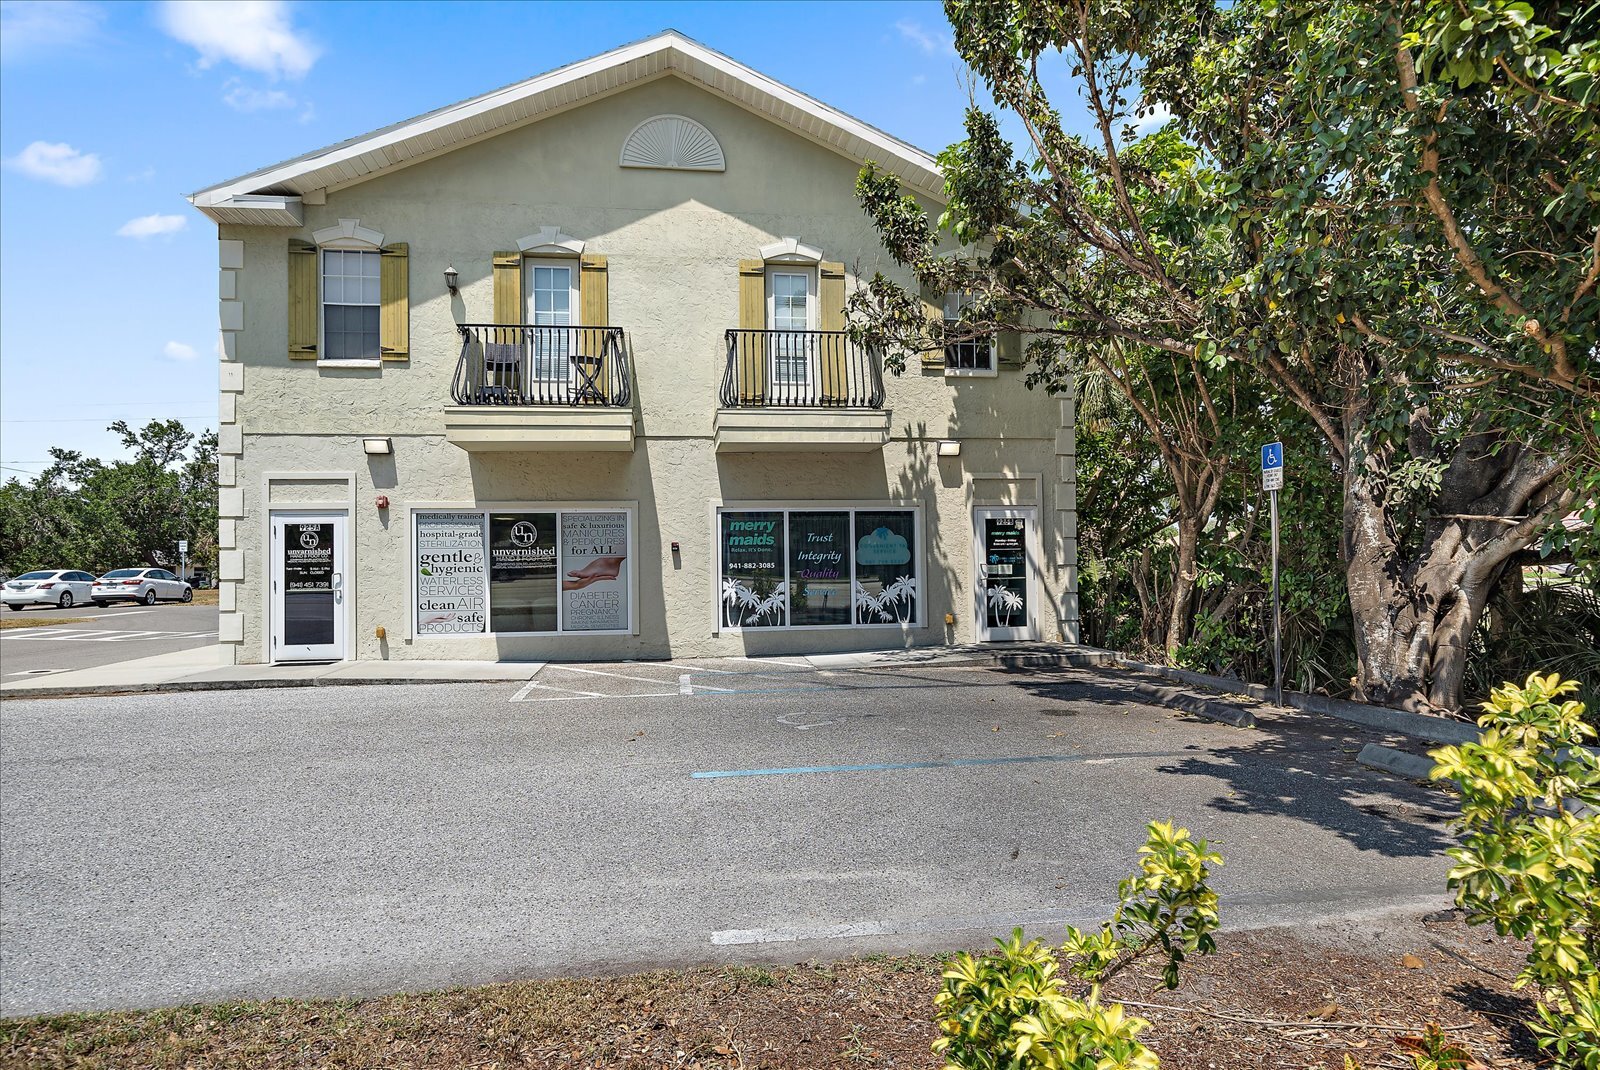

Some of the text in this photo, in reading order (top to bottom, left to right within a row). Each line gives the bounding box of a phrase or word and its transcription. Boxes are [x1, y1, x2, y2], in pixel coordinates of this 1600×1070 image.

[420, 513, 455, 521] medically
[730, 521, 775, 532] merry
[420, 530, 483, 540] hospital-grade
[563, 529, 624, 537] MANICURES
[808, 533, 833, 542] Trust
[730, 534, 774, 545] maids
[492, 547, 555, 555] unvarnished
[571, 546, 616, 554] for ALL
[420, 550, 483, 567] gentle &
[798, 551, 842, 564] Integrity
[431, 563, 483, 576] hygienic
[801, 568, 839, 579] Quality
[420, 577, 483, 585] WATERLESS
[420, 586, 483, 595] SERVICES
[570, 591, 619, 600] DIABETES
[420, 598, 483, 610] clean AIR
[570, 600, 620, 609] CANCER
[457, 612, 483, 622] safe
[420, 623, 484, 632] PRODUCTS
